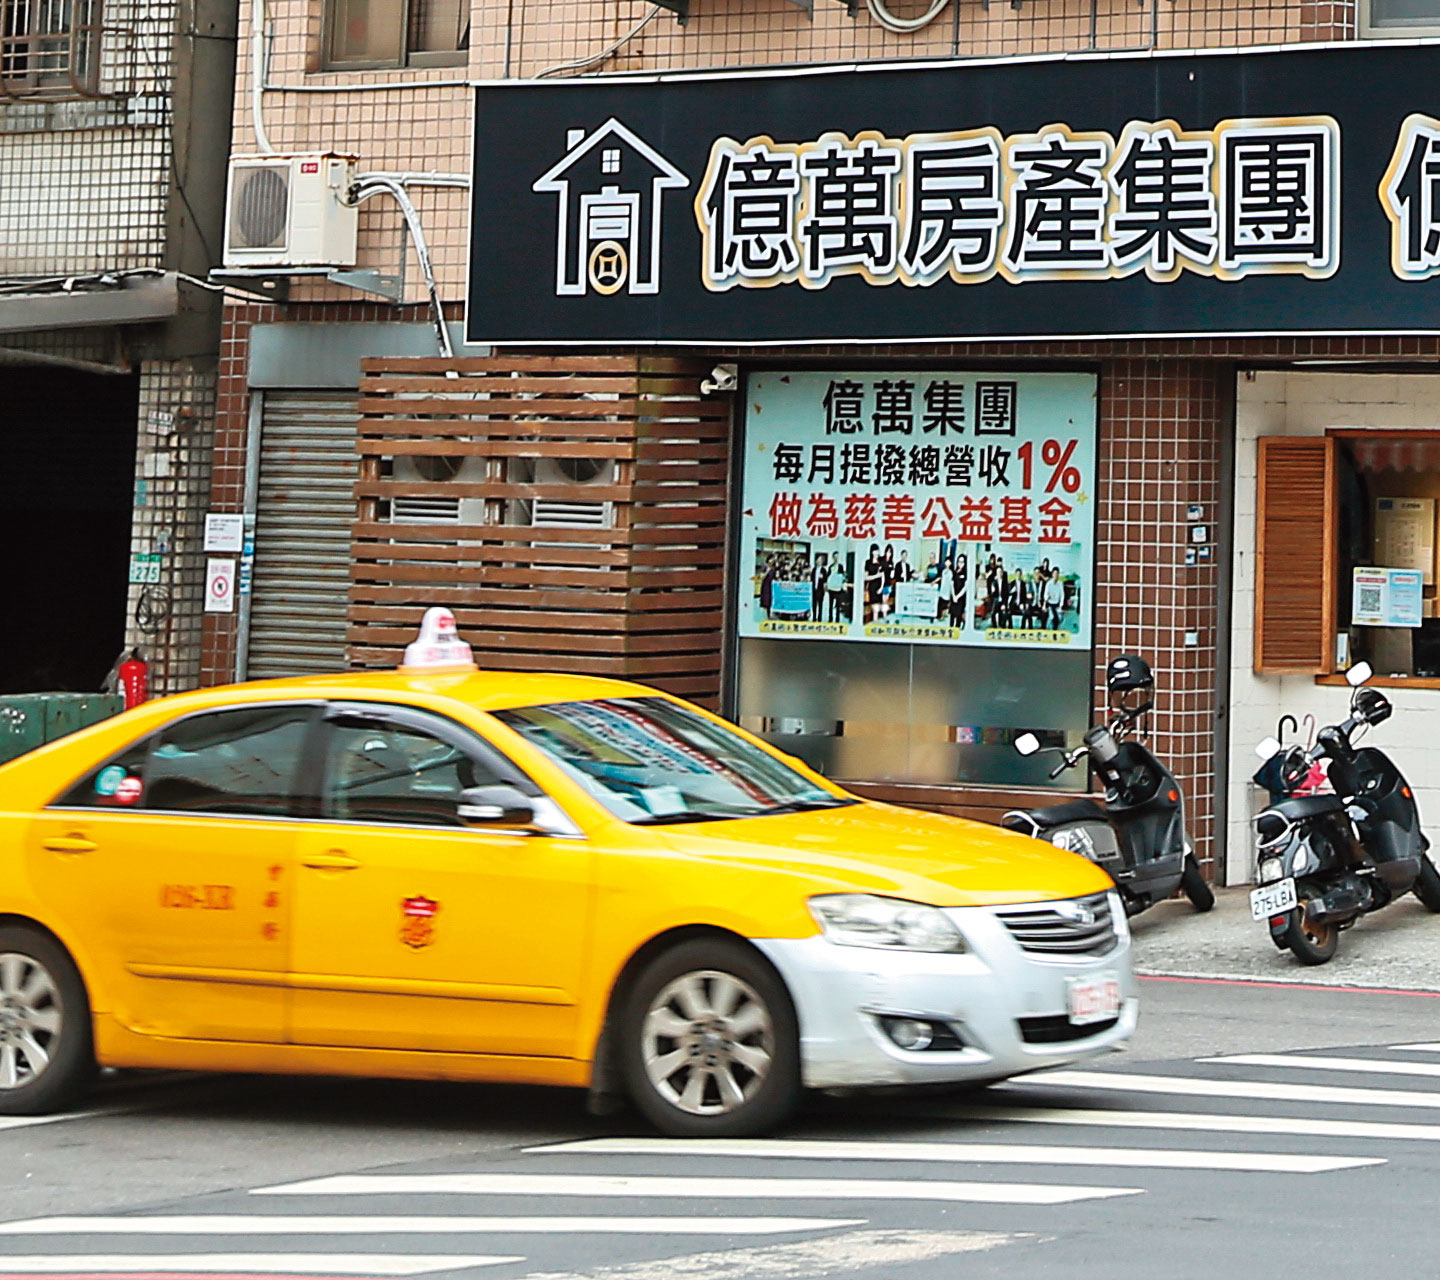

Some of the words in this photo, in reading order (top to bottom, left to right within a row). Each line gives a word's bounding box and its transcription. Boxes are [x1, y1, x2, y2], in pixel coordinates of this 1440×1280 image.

[703, 128, 1331, 278] 億萬房產集團
[823, 380, 1017, 437] 億萬集團
[773, 439, 1081, 494] 每月提撥總營收1%
[769, 492, 1073, 544] 做為慈善公益基金
